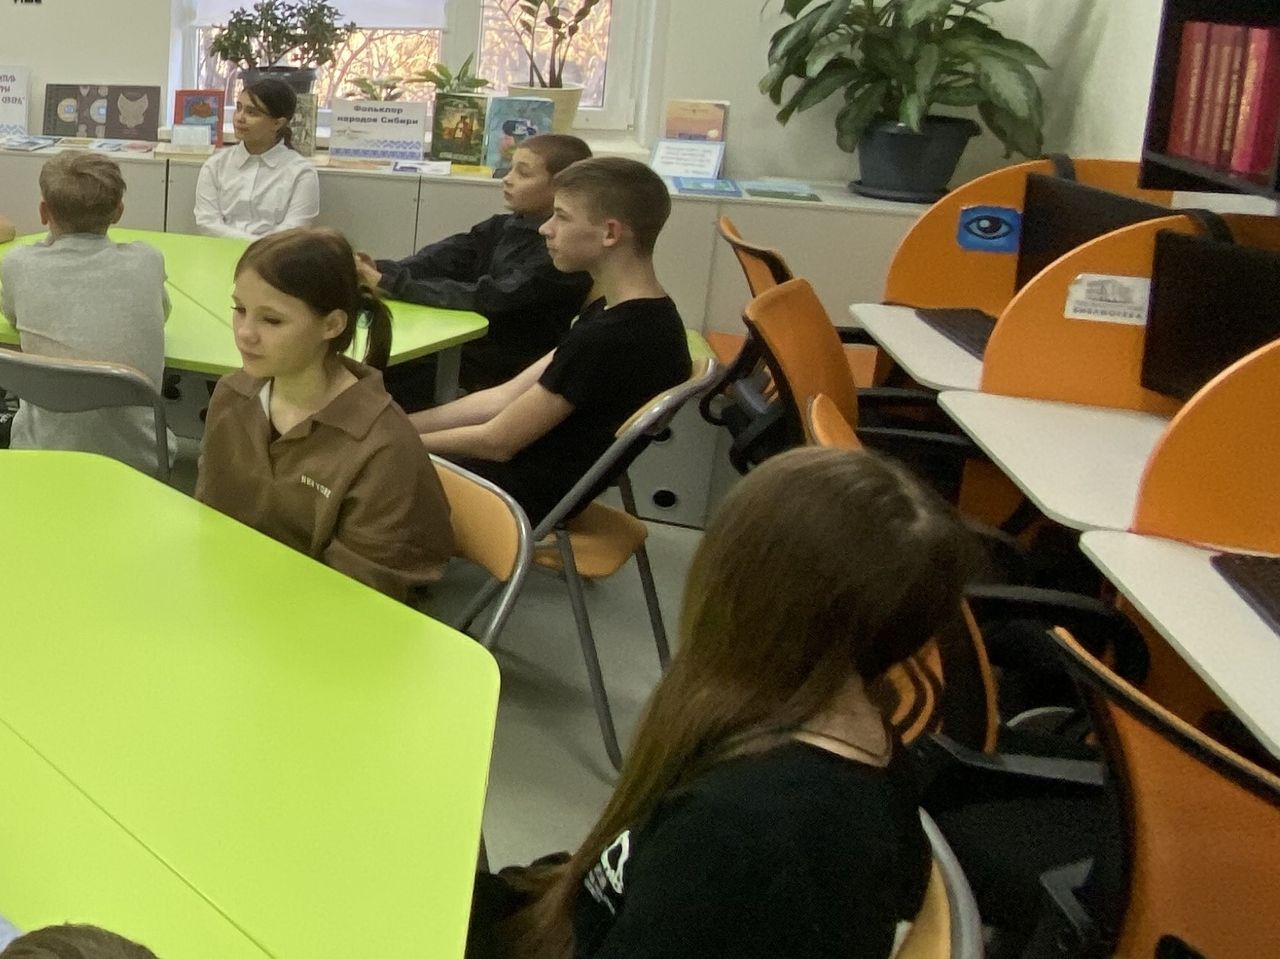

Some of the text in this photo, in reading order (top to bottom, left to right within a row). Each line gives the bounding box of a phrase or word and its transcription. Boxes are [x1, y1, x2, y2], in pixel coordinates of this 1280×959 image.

[354, 105, 403, 114] Фольклор
[337, 115, 419, 125] народов Сибири
